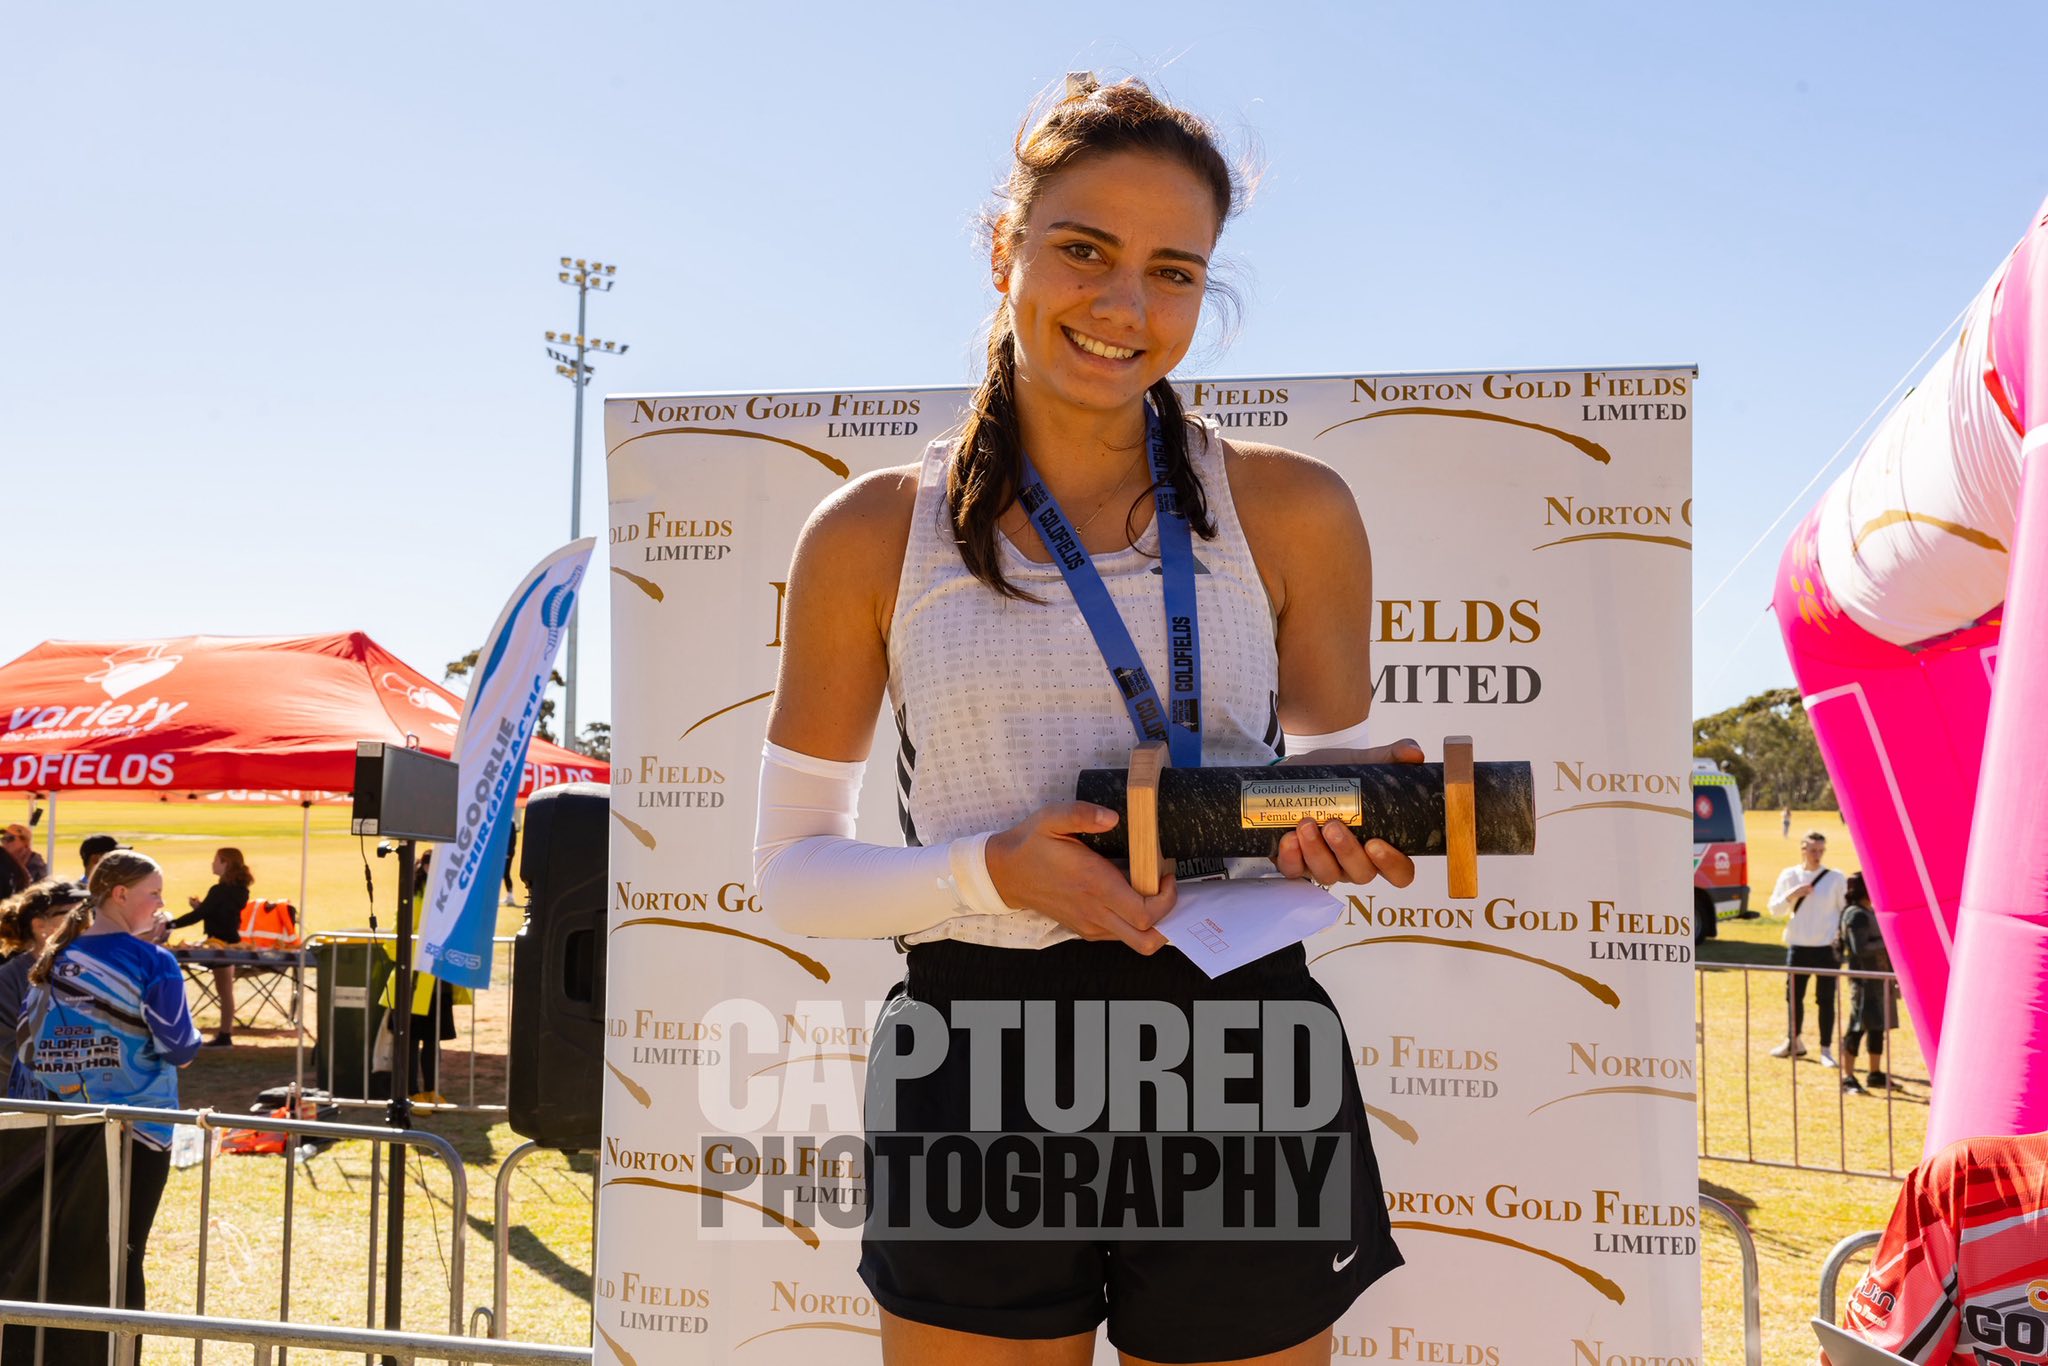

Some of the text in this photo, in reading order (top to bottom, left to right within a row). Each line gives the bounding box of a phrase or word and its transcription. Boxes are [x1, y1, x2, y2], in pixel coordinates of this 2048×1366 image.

[1349, 372, 1687, 403] NORTON GOLD FIELDS
[632, 394, 921, 423] NORTON GOLD FIELDS
[1582, 403, 1687, 422] LIMITED
[827, 421, 918, 438] LIMITED
[645, 511, 733, 539] FIELDS
[1543, 497, 1672, 527] NORTON
[1038, 506, 1086, 572] GOLDFIELDS
[1172, 616, 1194, 693] GOLDFIELDS
[9, 697, 189, 731] variety
[638, 756, 725, 785] FIELDS
[1553, 760, 1680, 795] NORTON
[638, 791, 724, 809] LIMITED
[1252, 783, 1350, 795] Goldfields Pipeline
[1265, 797, 1337, 808] MARATHON
[435, 716, 517, 913] KALGOORLIE
[1260, 811, 1297, 822] Female
[1316, 810, 1343, 820] Place
[615, 881, 708, 912] NORTON
[1344, 894, 1691, 936] NORTON GOLD FIELDS
[1590, 941, 1691, 964] LIMITED
[54, 1025, 93, 1037] 2024
[633, 1009, 722, 1041] FIELDS
[632, 1047, 721, 1067] LIMITED
[1388, 1035, 1499, 1072] FIELDS
[1567, 1042, 1692, 1079] NORTON
[1389, 1076, 1499, 1099] LIMITED
[605, 1136, 865, 1180] NORTON GOLD FIEL
[1485, 1184, 1582, 1222] GOLD
[1592, 1189, 1696, 1227] FIELDS
[1593, 1233, 1697, 1256] LIMITED
[620, 1272, 710, 1309] FIELDS
[619, 1311, 708, 1335] LIMITED
[1388, 1326, 1499, 1366] FIELDS
